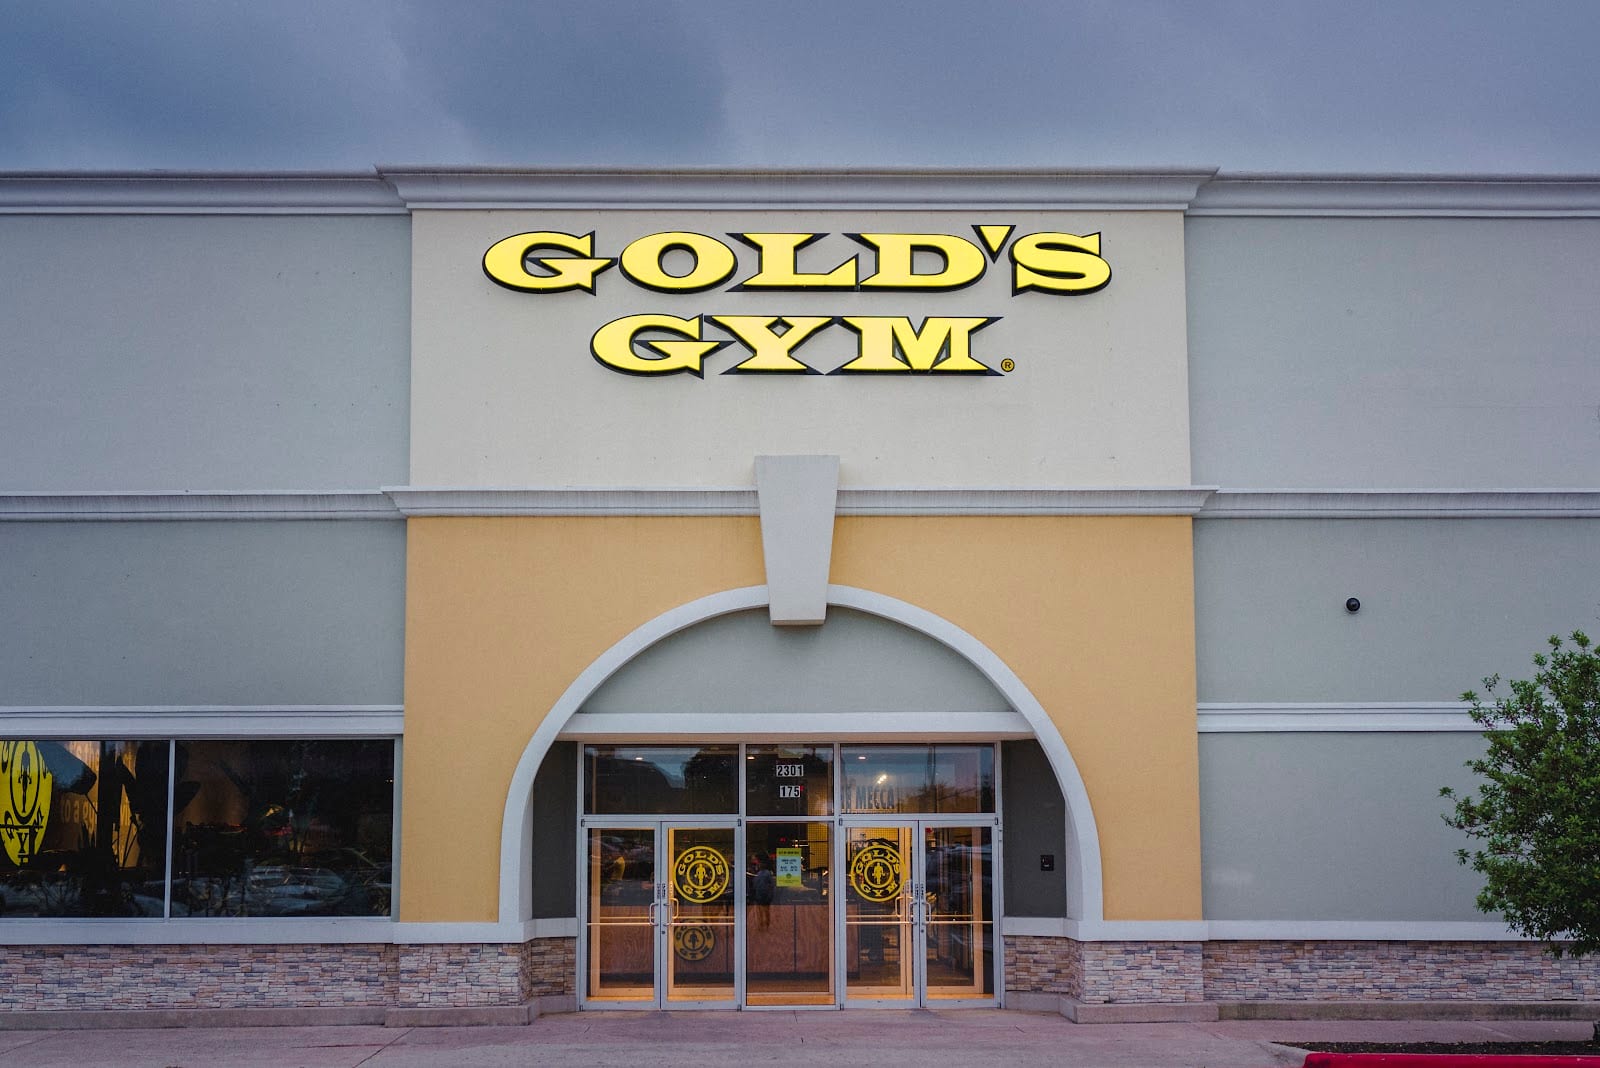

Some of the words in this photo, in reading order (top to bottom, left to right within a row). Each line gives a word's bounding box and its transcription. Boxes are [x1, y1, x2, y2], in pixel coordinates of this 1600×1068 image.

[482, 225, 1112, 296] GOLD'S
[590, 313, 1005, 379] GYM
[777, 765, 803, 776] 2301
[781, 786, 800, 797] 175
[856, 785, 895, 809] MECCA
[677, 850, 725, 876] GOLD'S
[855, 849, 901, 875] GOLD'S
[682, 883, 721, 899] GYM
[860, 882, 898, 897] GYM
